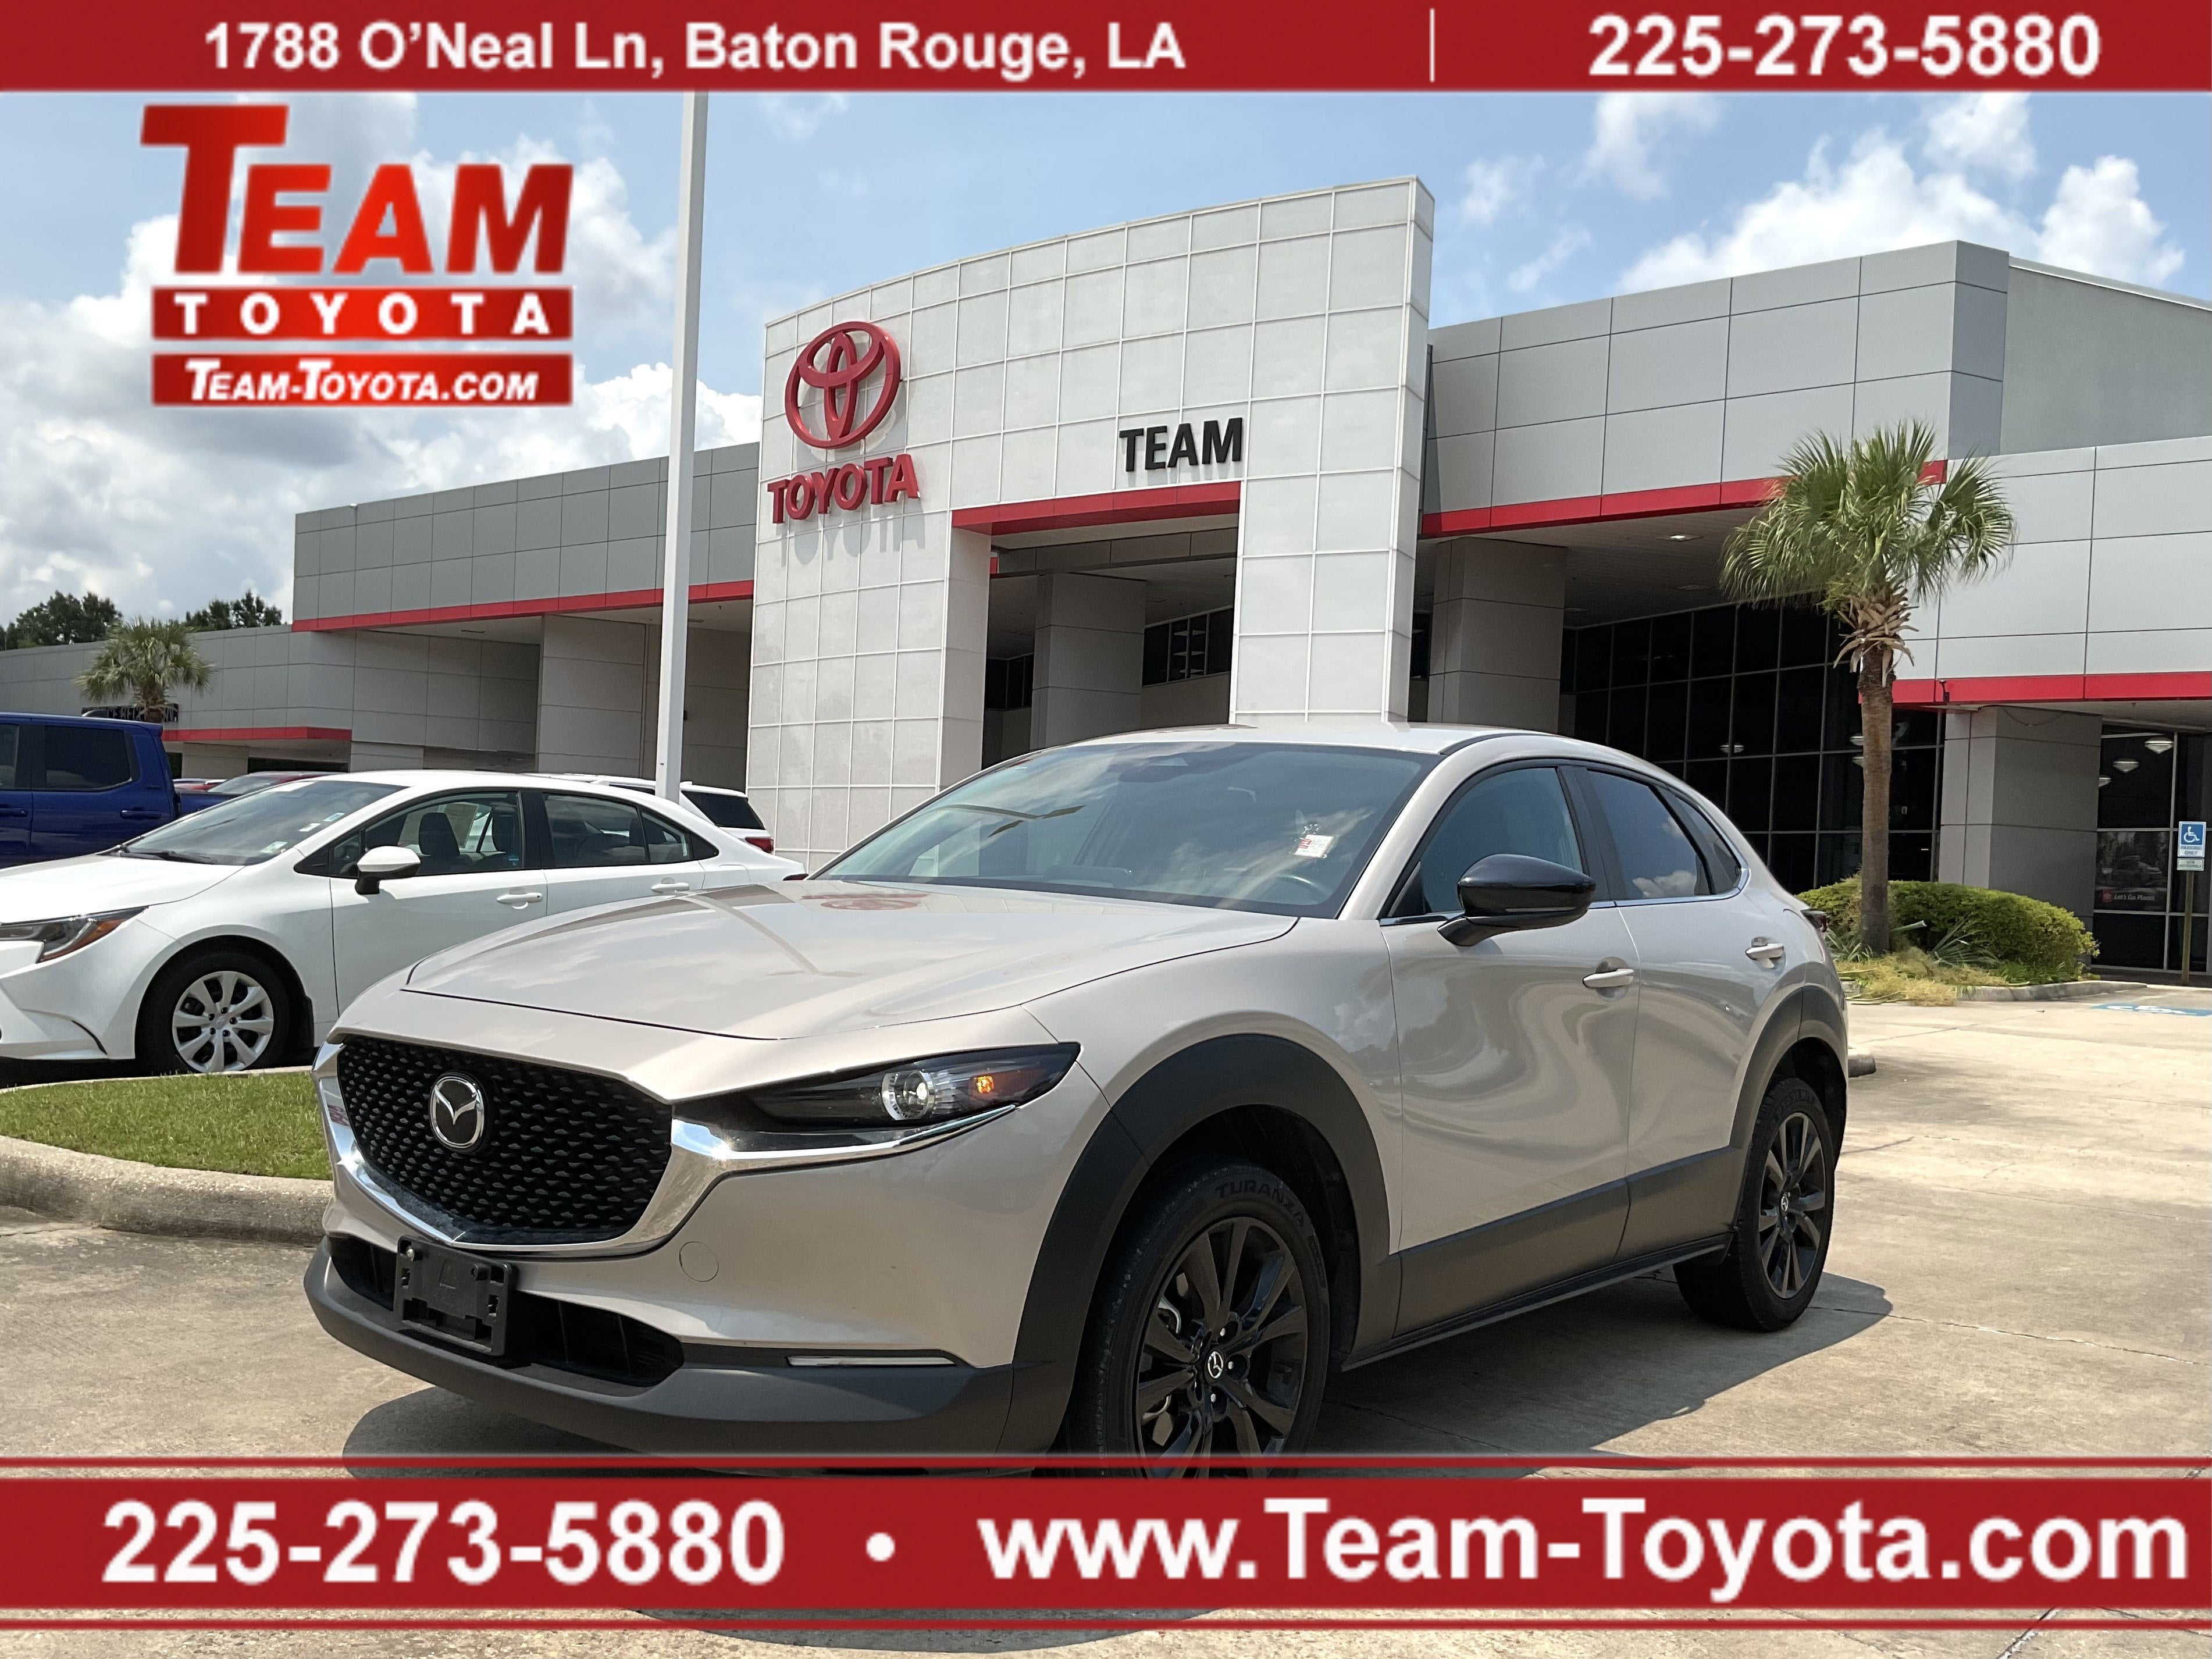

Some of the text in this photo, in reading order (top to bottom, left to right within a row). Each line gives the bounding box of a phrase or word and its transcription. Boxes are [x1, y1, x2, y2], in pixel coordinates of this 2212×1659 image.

[1119, 417, 1242, 472] TEAM
[767, 453, 920, 525] TOYOTA
[1215, 1180, 1306, 1226] TURANZA
